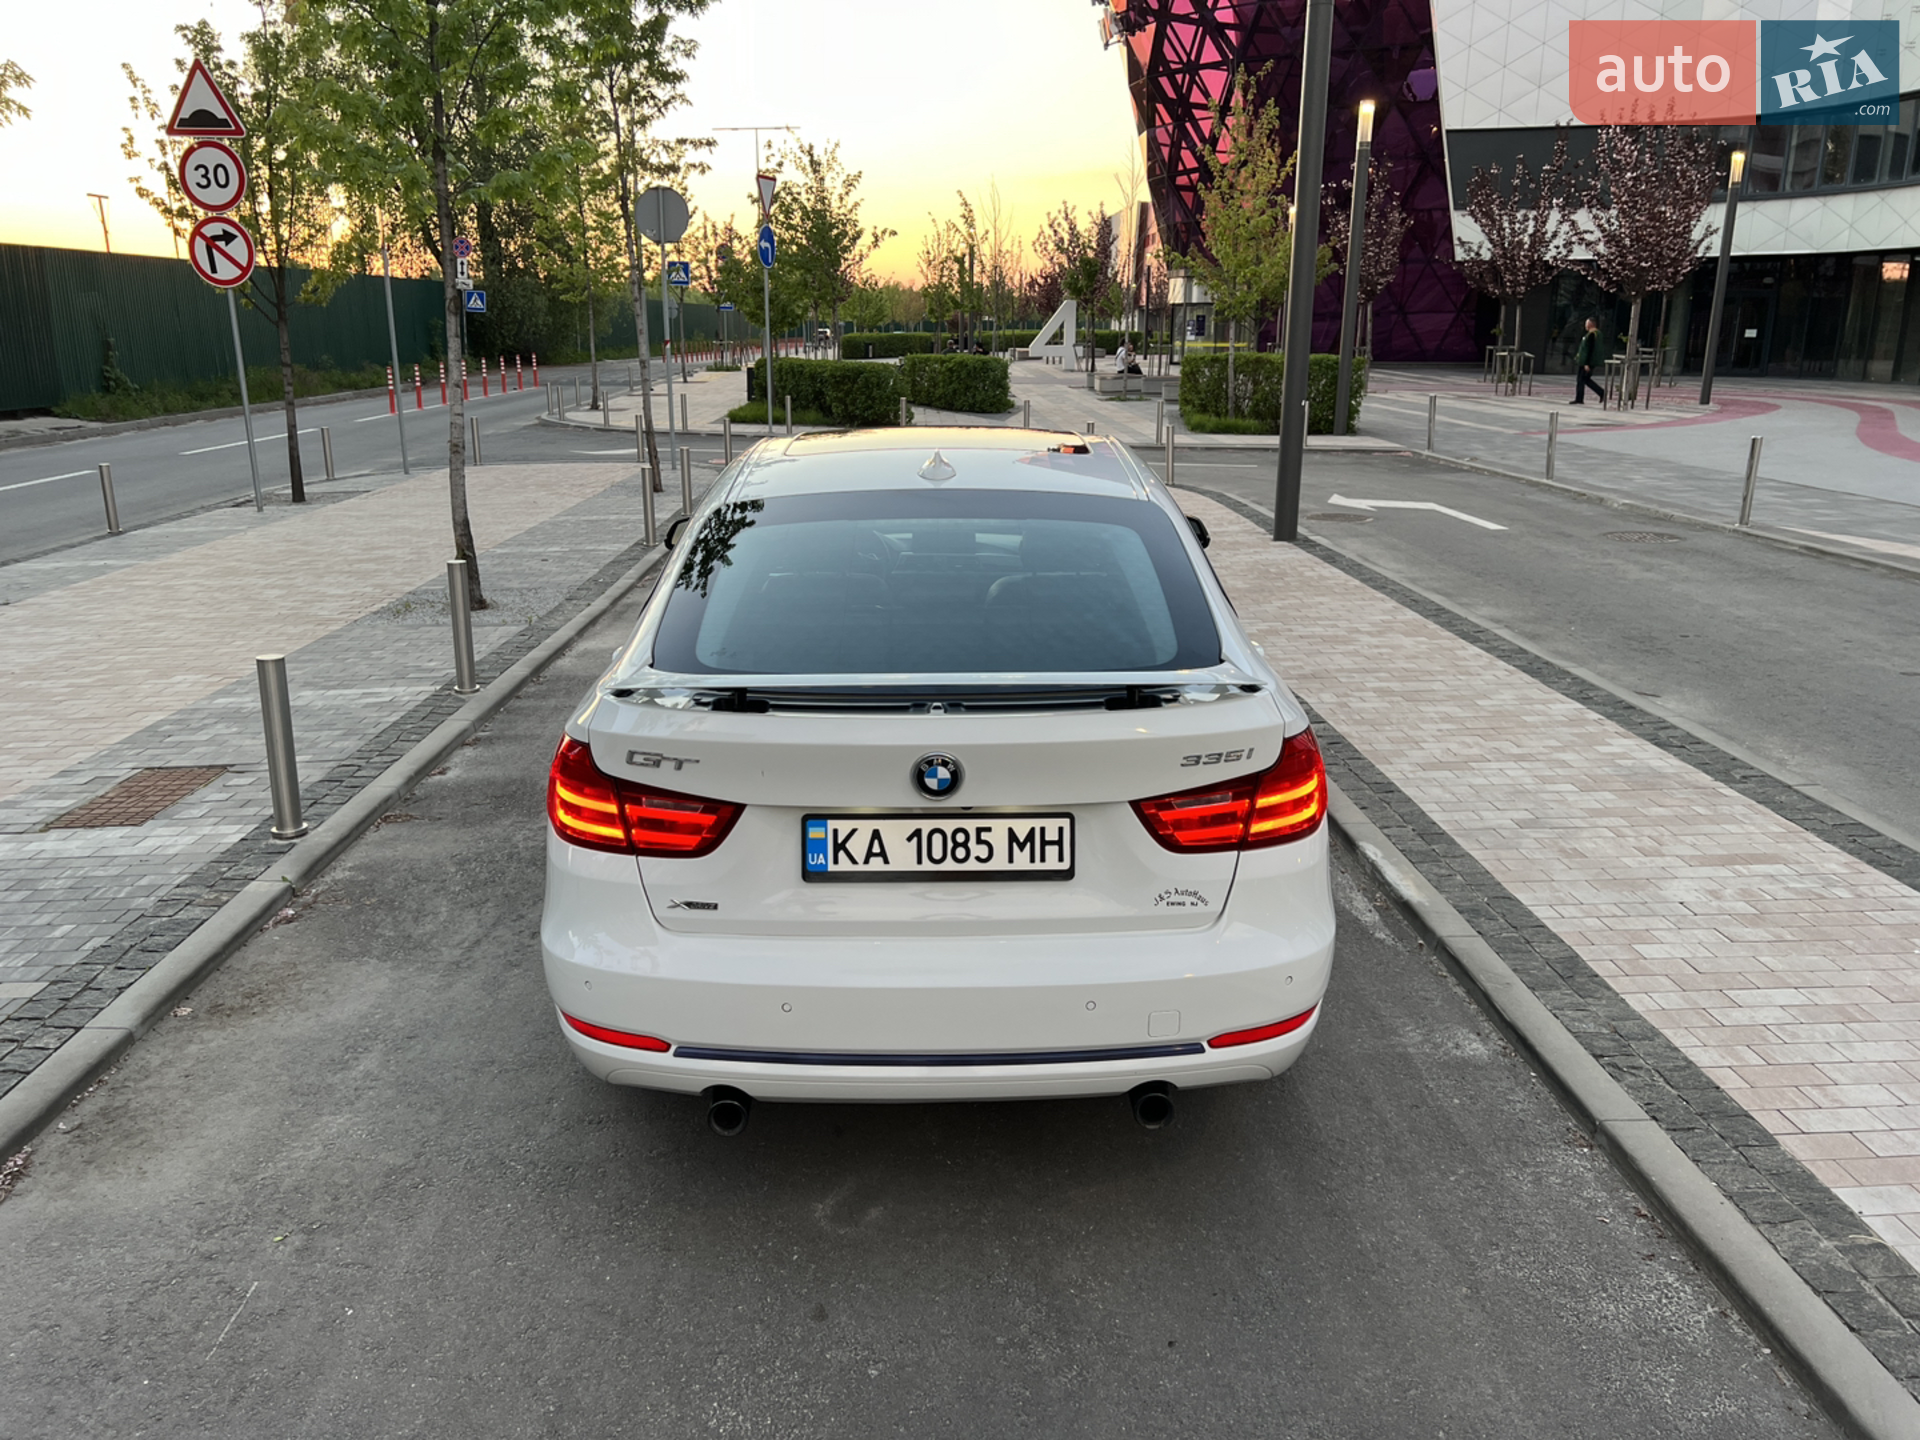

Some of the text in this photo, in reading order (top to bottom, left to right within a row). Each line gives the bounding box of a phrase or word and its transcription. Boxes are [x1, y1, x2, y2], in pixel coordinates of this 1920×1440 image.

[194, 163, 230, 190] 30
[1029, 299, 1077, 370] 4
[626, 749, 700, 771] GT
[920, 757, 956, 772] BMW
[832, 826, 1064, 865] KA 1085 MH
[808, 852, 826, 865] UA
